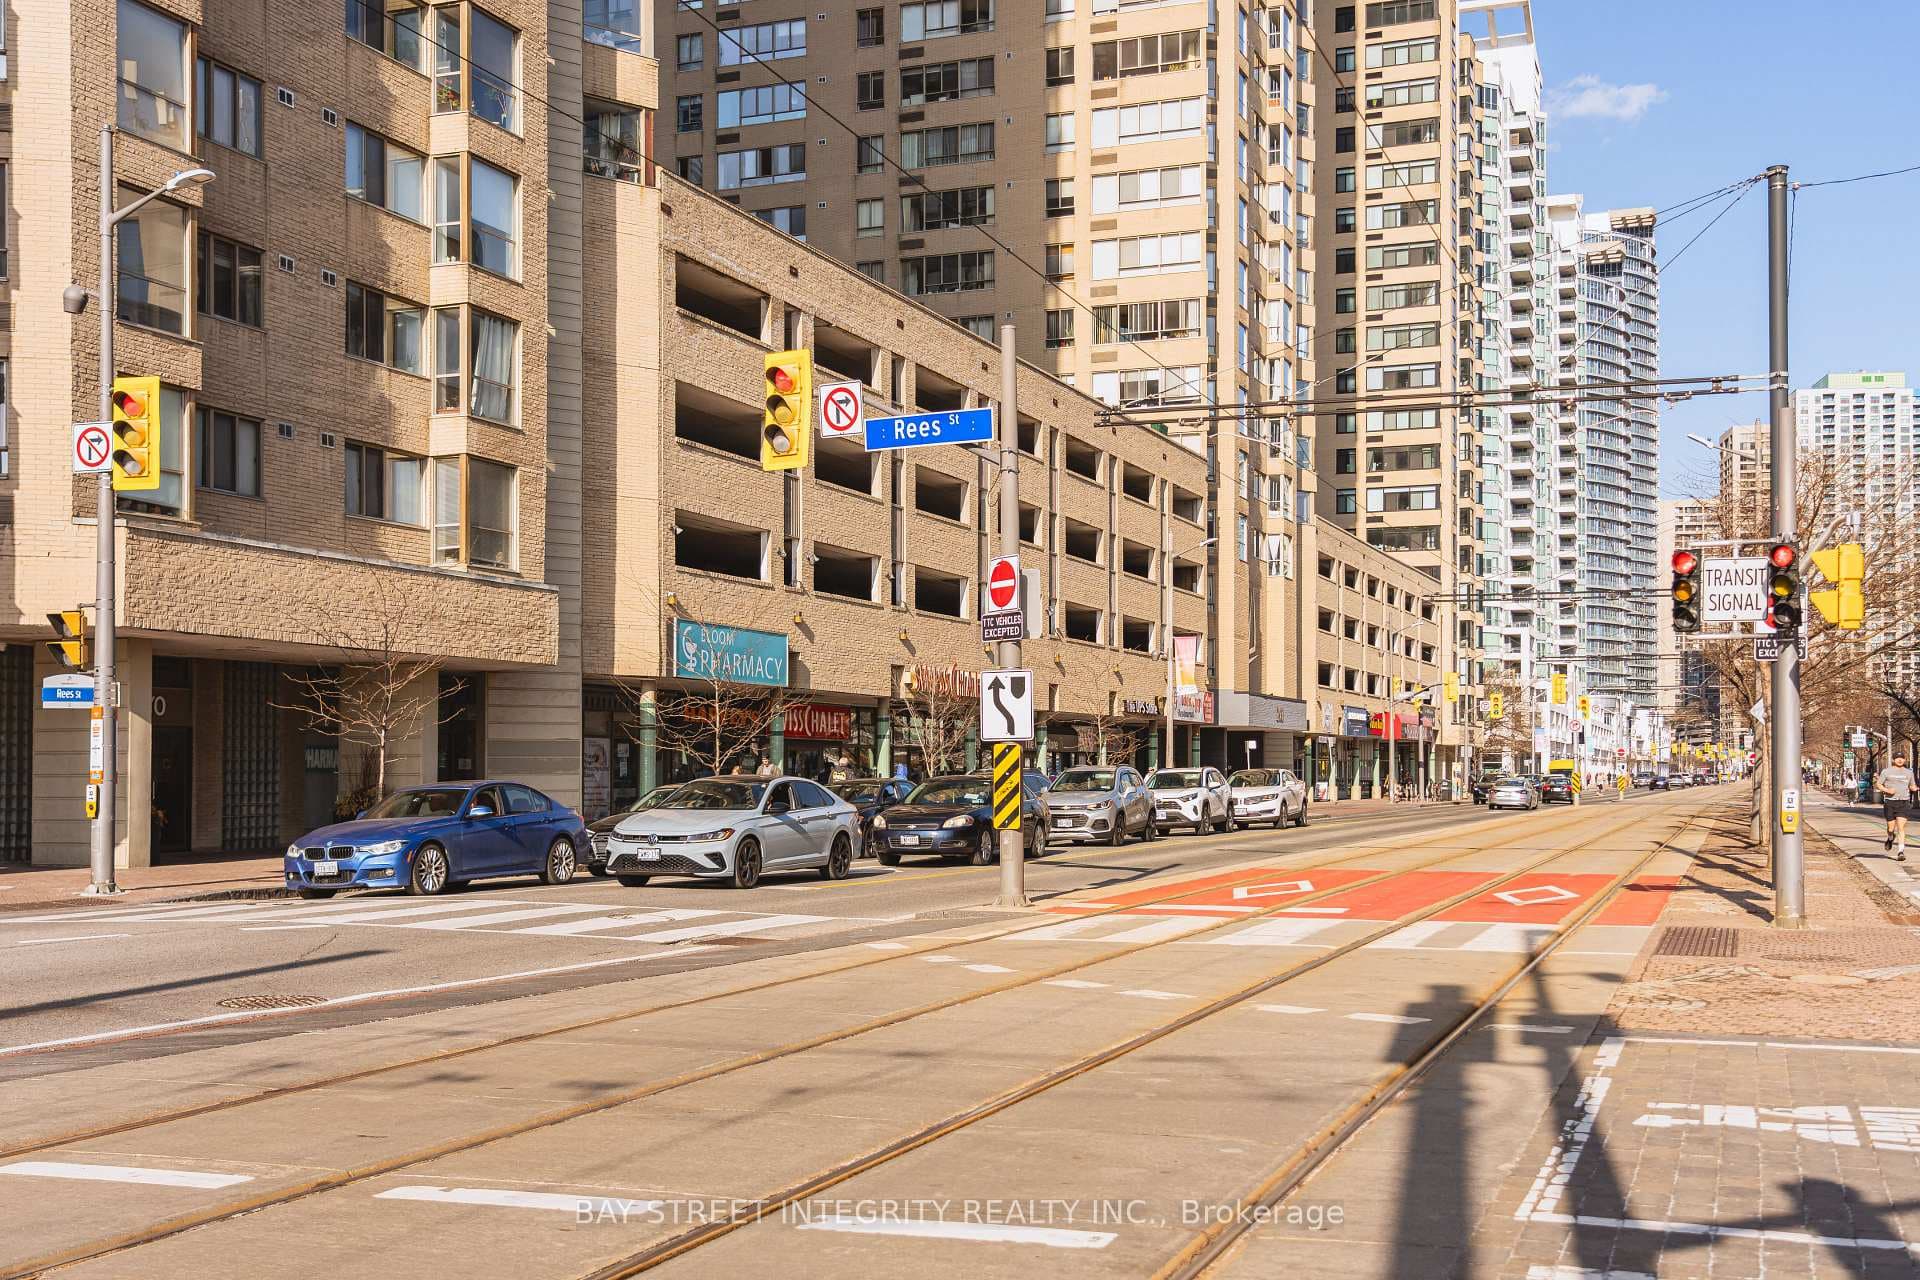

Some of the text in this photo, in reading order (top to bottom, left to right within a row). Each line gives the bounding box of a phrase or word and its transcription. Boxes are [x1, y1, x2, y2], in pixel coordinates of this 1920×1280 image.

[894, 414, 960, 440] Rees St
[1705, 568, 1767, 587] TRANSIT
[1708, 593, 1762, 611] SIGNAL
[983, 615, 1021, 627] TTC VEHICLES
[984, 626, 1020, 638] EXCEPTED
[1756, 639, 1771, 648] TTC
[701, 649, 783, 681] PHARMACY
[56, 688, 74, 699] Rees
